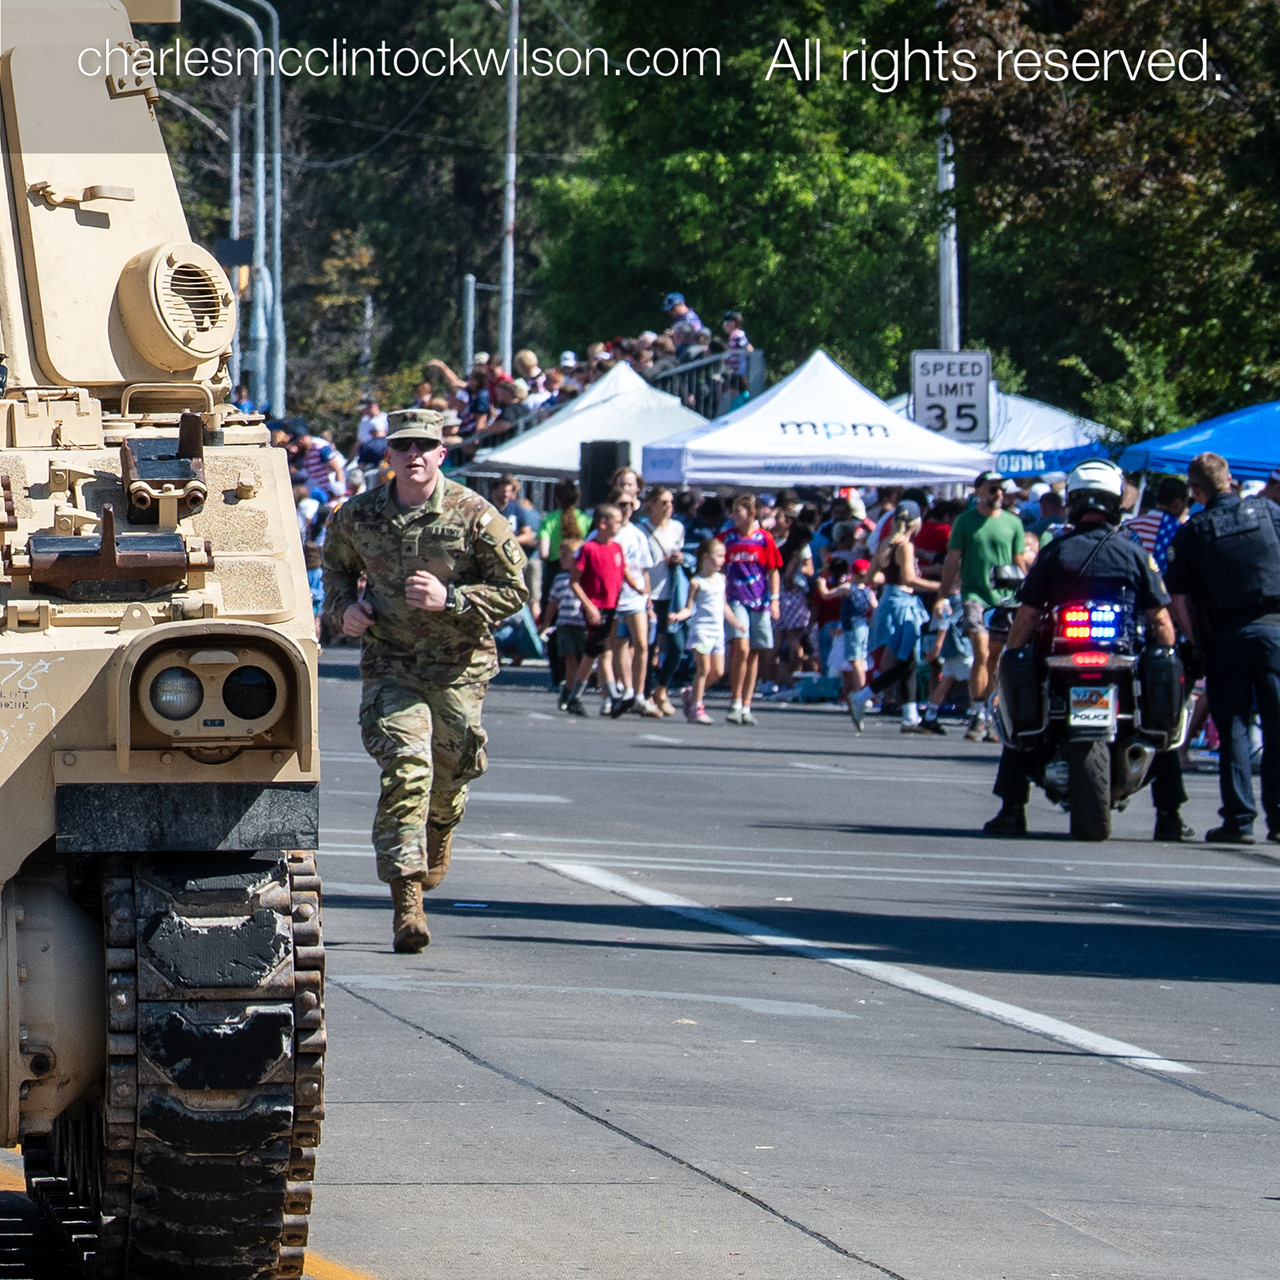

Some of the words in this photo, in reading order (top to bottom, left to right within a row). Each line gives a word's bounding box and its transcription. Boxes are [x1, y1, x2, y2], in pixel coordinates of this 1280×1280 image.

[920, 361, 983, 376] SPEED
[926, 383, 975, 397] LIMIT
[926, 403, 978, 434] 35
[780, 420, 890, 440] mpm
[0, 690, 29, 699] LIFT
[0, 701, 30, 710] HERE
[1072, 713, 1110, 721] POLICE
